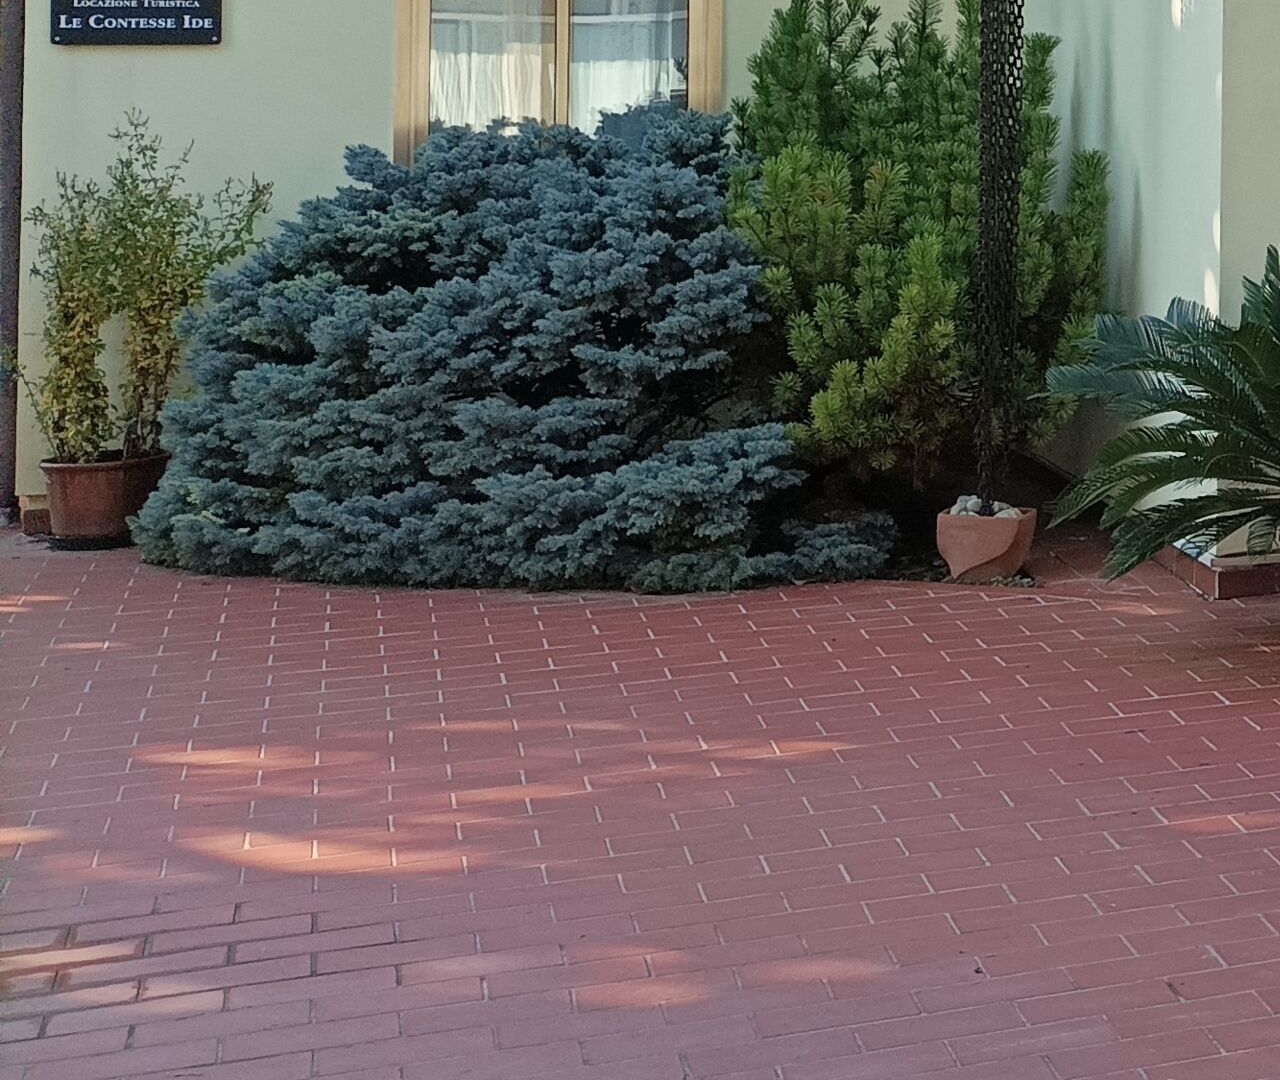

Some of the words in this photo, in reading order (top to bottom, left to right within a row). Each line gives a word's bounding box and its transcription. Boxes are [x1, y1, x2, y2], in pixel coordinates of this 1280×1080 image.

[59, 15, 82, 28] LE
[88, 14, 177, 28] CONTESSE
[183, 15, 213, 28] IDE
